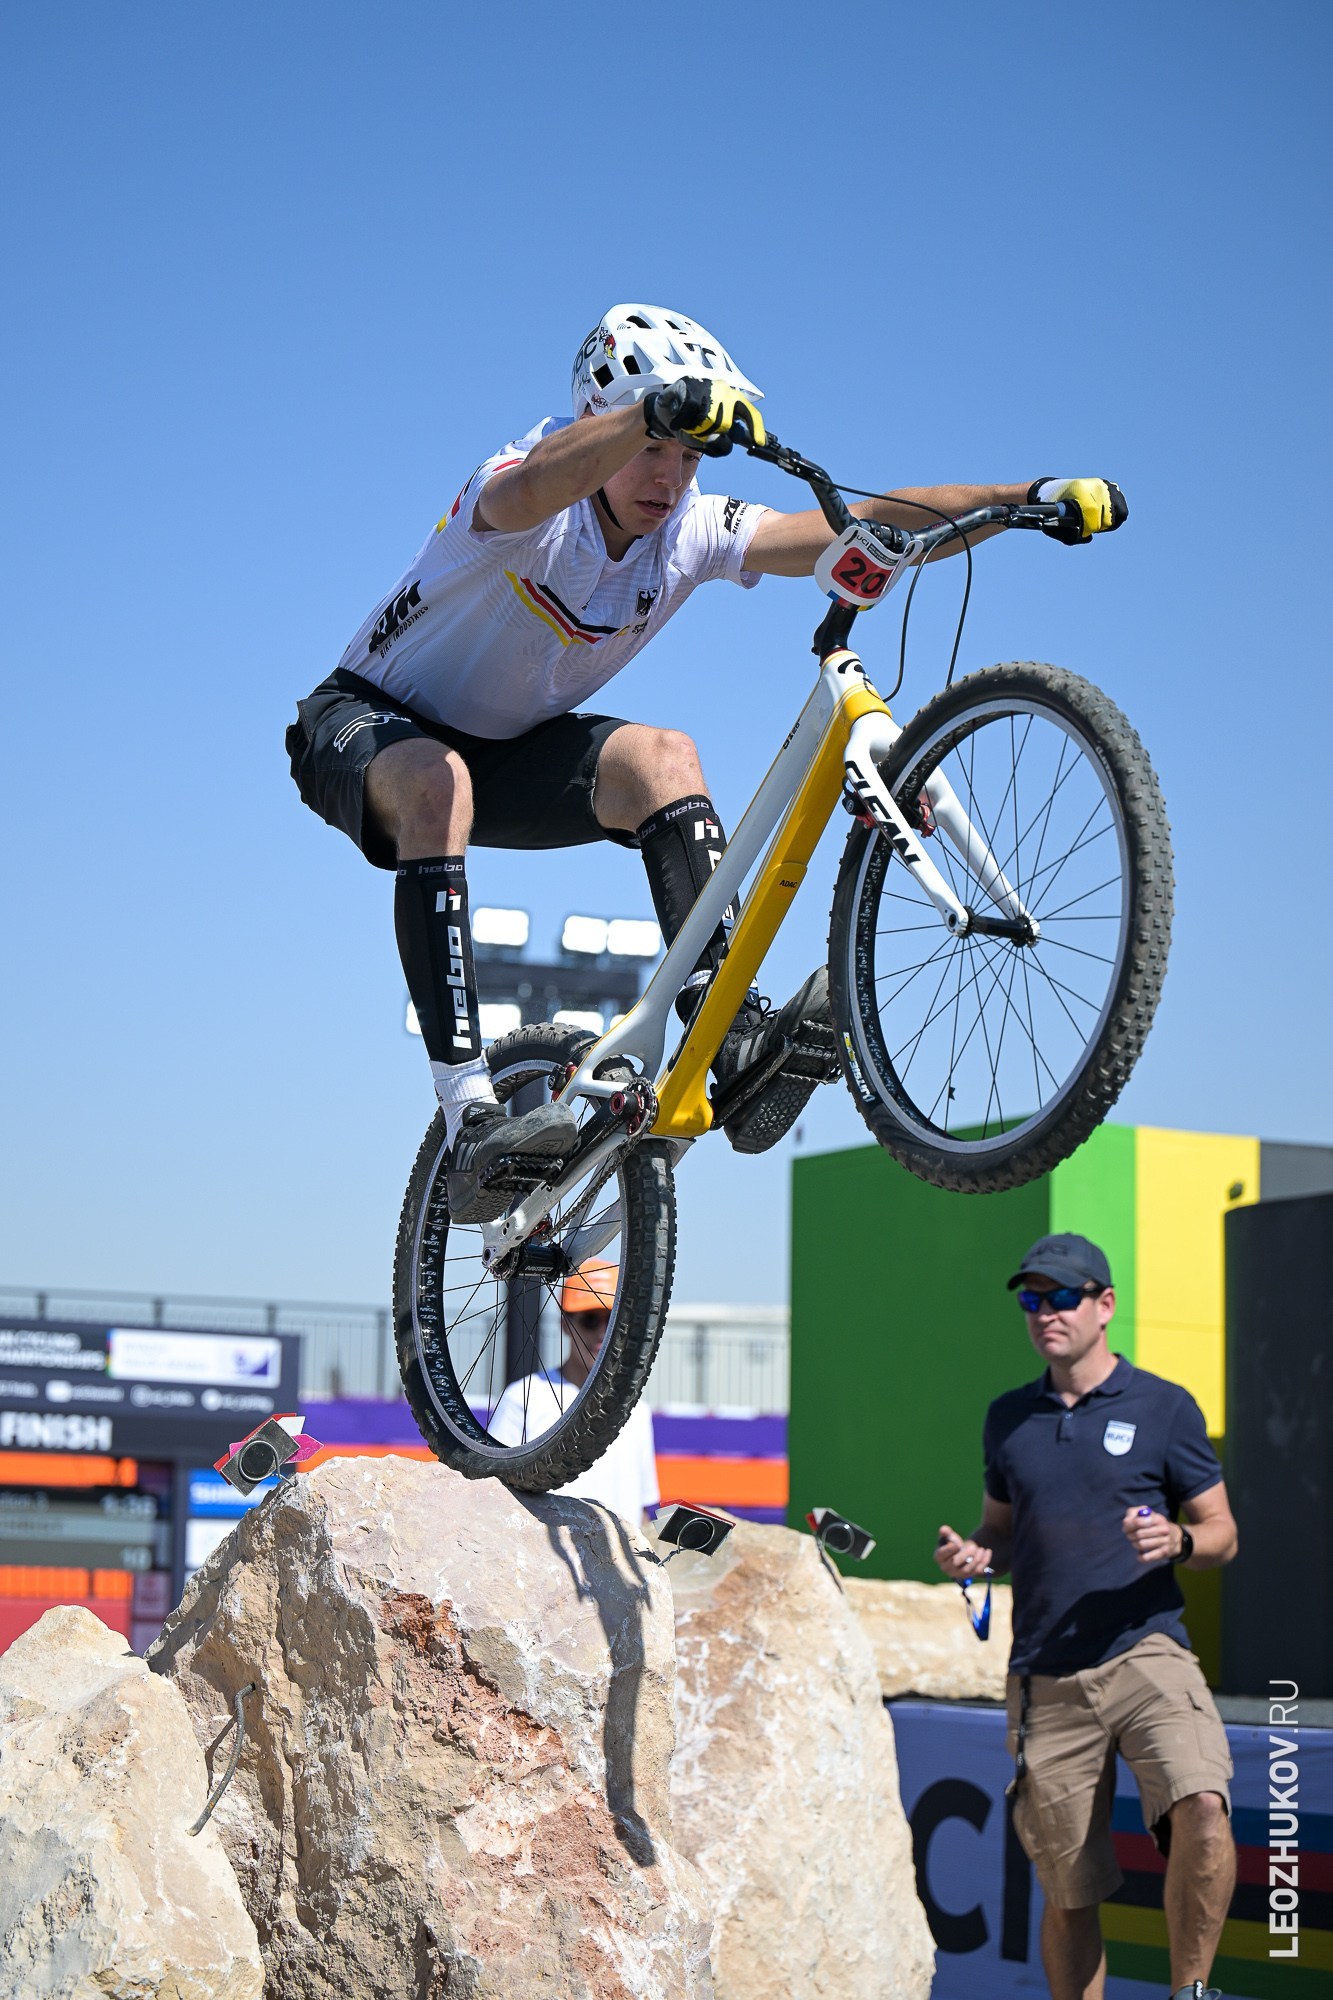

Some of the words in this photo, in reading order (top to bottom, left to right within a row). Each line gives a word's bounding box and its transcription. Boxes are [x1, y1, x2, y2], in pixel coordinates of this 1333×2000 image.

[856, 536, 870, 547] UCI
[839, 557, 887, 595] 20
[380, 640, 393, 659] BIKE
[393, 605, 429, 640] INDUSTRIES
[665, 801, 710, 822] hebo
[845, 760, 921, 865] CLEAN
[418, 863, 463, 875] hebo
[778, 879, 798, 889] ADAC
[446, 925, 473, 1050] hebo
[0, 1411, 112, 1451] FINISH
[910, 1776, 1032, 1964] CI
